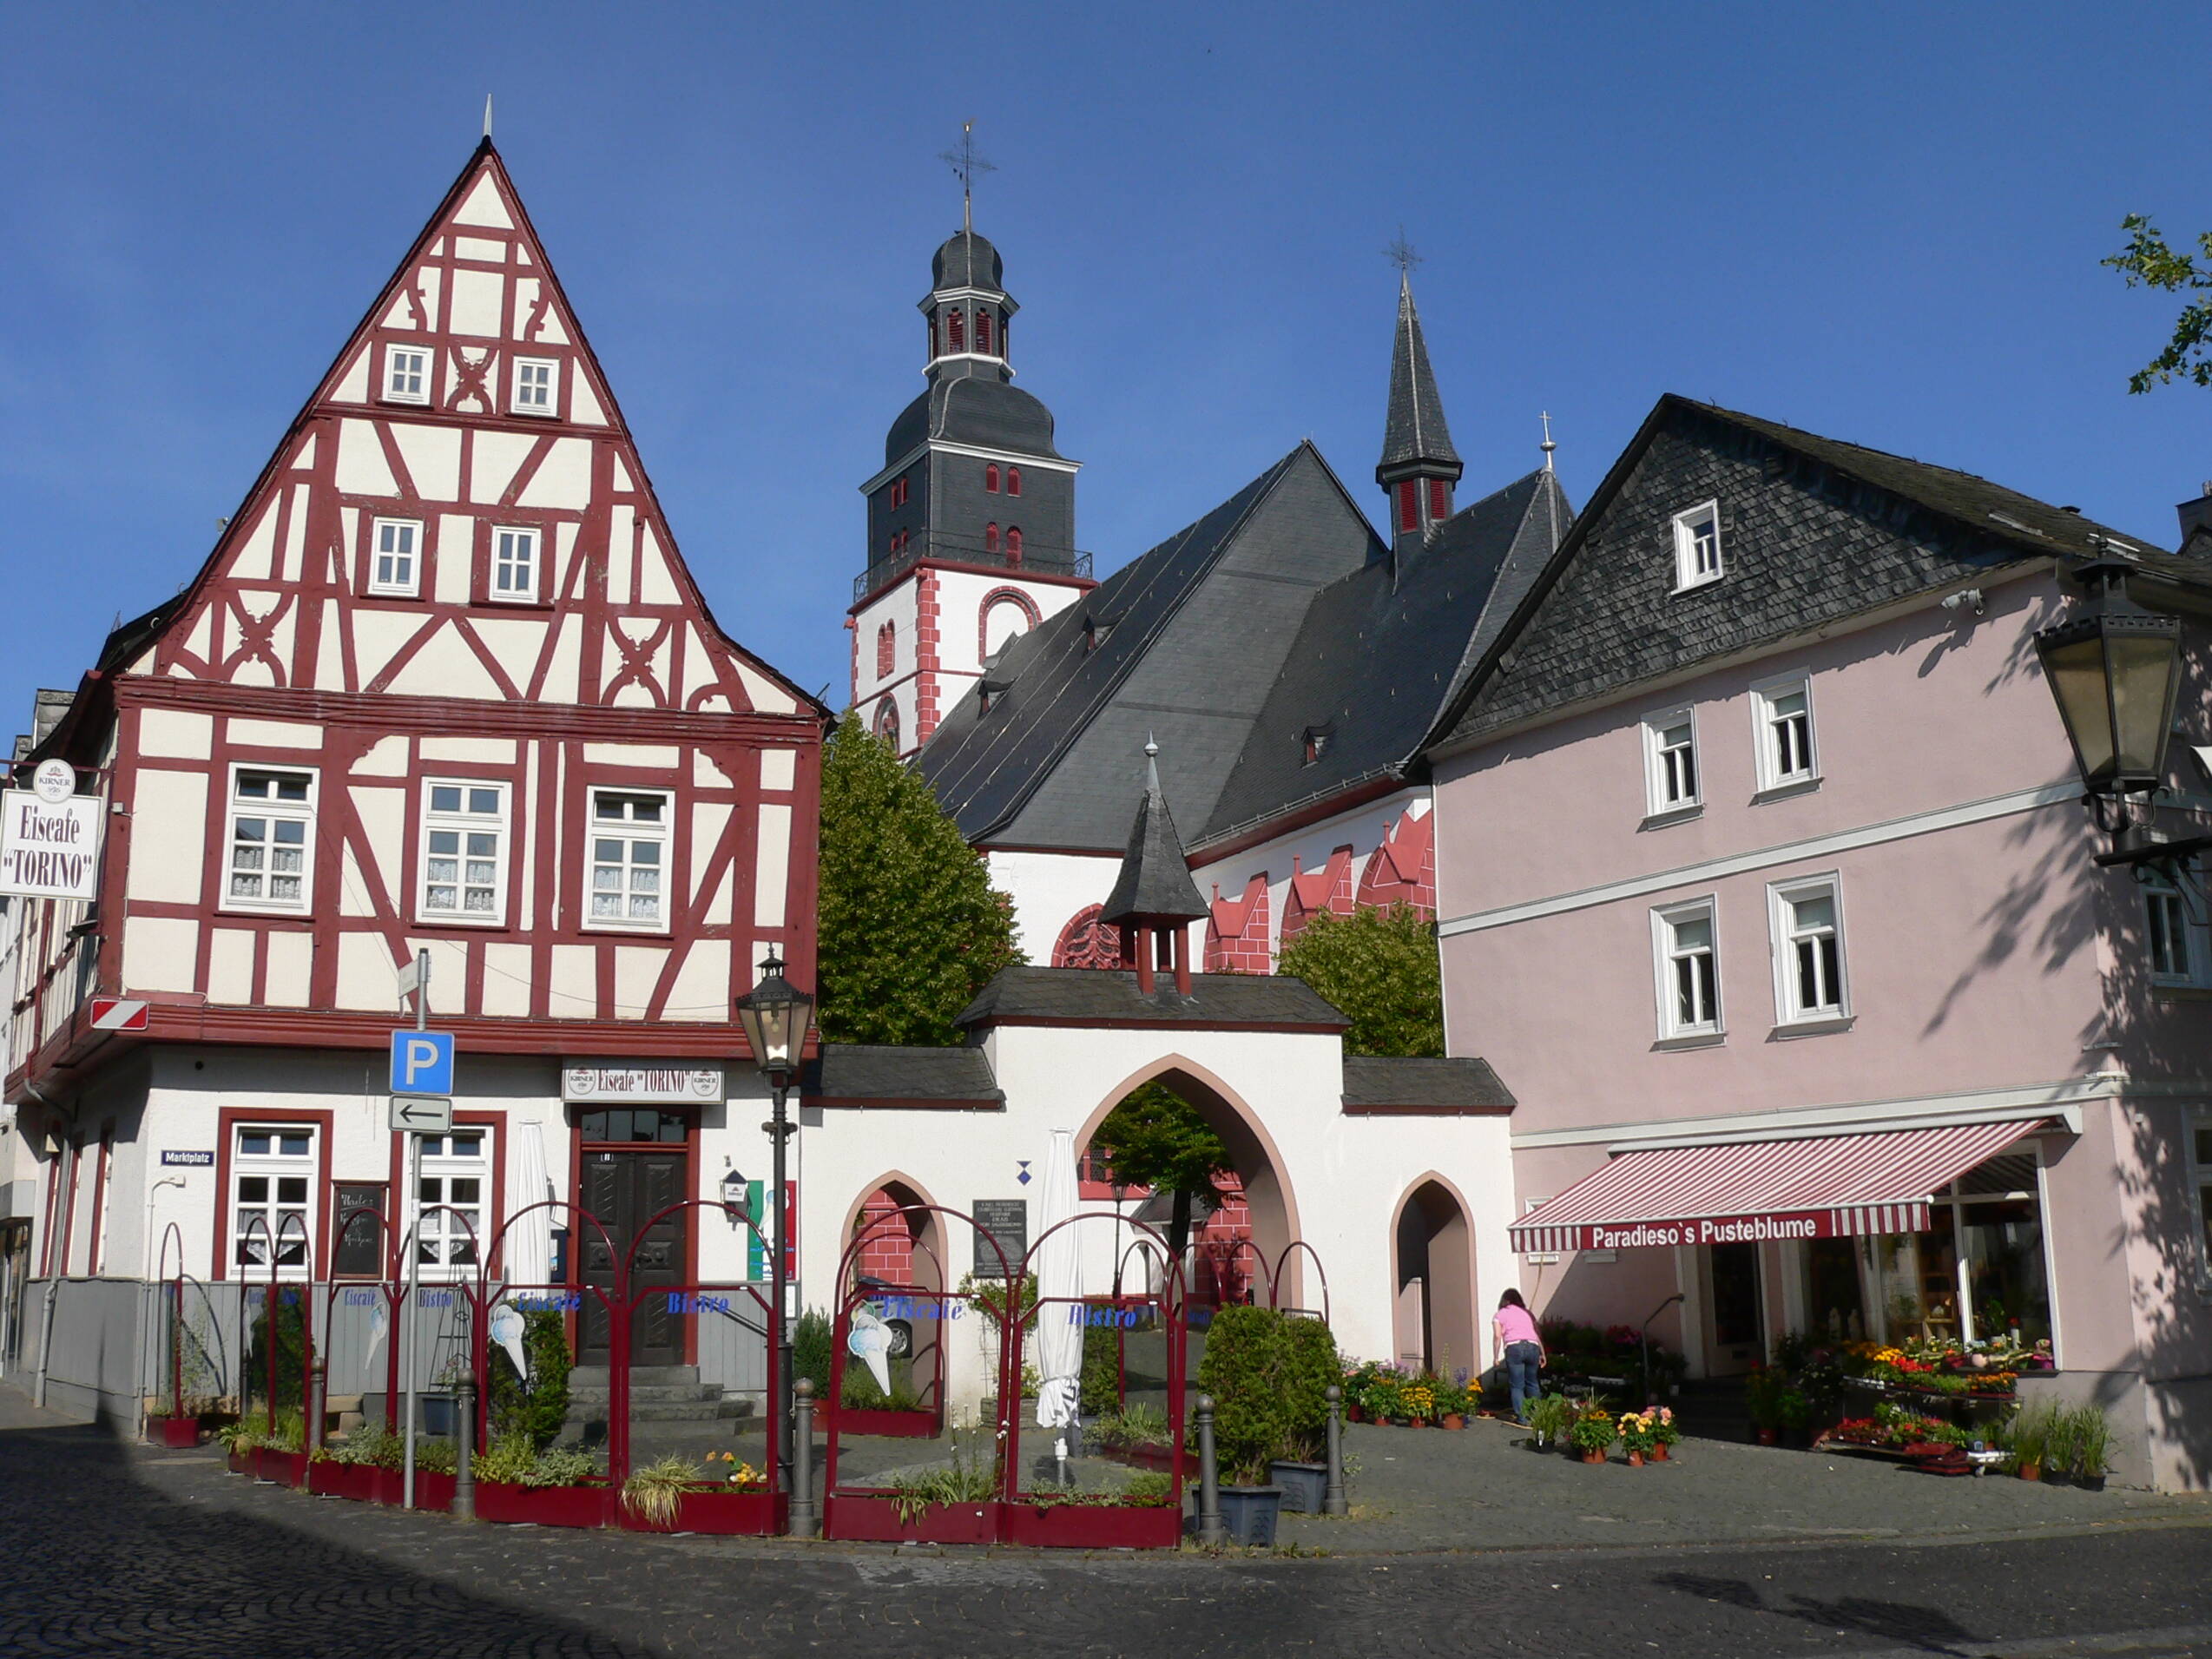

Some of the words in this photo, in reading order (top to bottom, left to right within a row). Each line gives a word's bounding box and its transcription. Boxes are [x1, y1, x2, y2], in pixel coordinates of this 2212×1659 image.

[38, 777, 71, 787] KIRNER
[19, 805, 80, 845] Eiscafe
[406, 1039, 438, 1085] P
[166, 1152, 210, 1164] Marktplatz
[1701, 1216, 1817, 1244] Pusteblume
[668, 1291, 730, 1314] Bistro
[1068, 1304, 1138, 1327] Bistro
